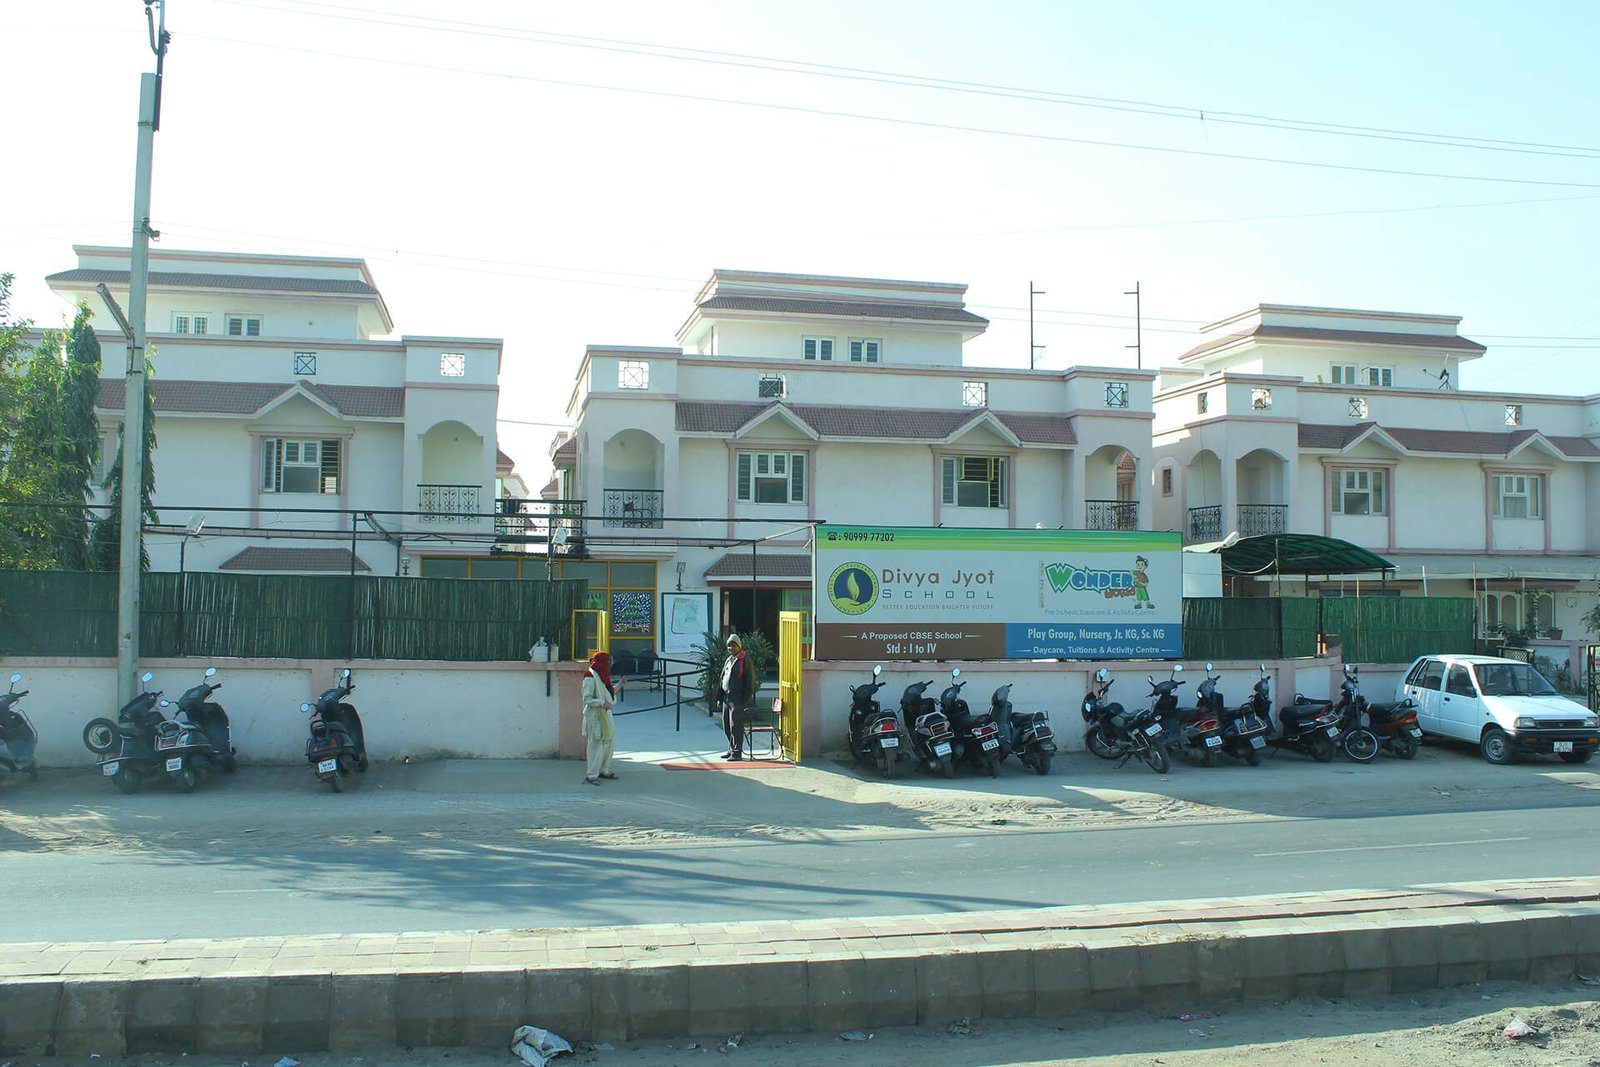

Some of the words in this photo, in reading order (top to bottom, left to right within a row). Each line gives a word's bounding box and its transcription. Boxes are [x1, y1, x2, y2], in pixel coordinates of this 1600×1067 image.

[844, 532, 868, 542] 90999
[870, 532, 894, 542] 77202
[882, 568, 940, 588] Divya
[952, 570, 994, 588] Jyot
[1045, 562, 1133, 593] WONDER
[882, 588, 994, 598] SCHOOL
[870, 632, 908, 640] Proposed
[1028, 628, 1046, 640] Play
[1048, 629, 1076, 640] Group,
[1079, 629, 1112, 641] Nursery,
[1114, 629, 1122, 639] Jr.
[1125, 629, 1139, 640] KG,
[1141, 629, 1150, 639] Sr.
[1153, 629, 1165, 639] KG
[886, 643, 900, 654] Std
[916, 644, 924, 654] to
[927, 643, 936, 653] IV
[1033, 646, 1066, 655] Daycare,
[1106, 646, 1133, 655] Activity
